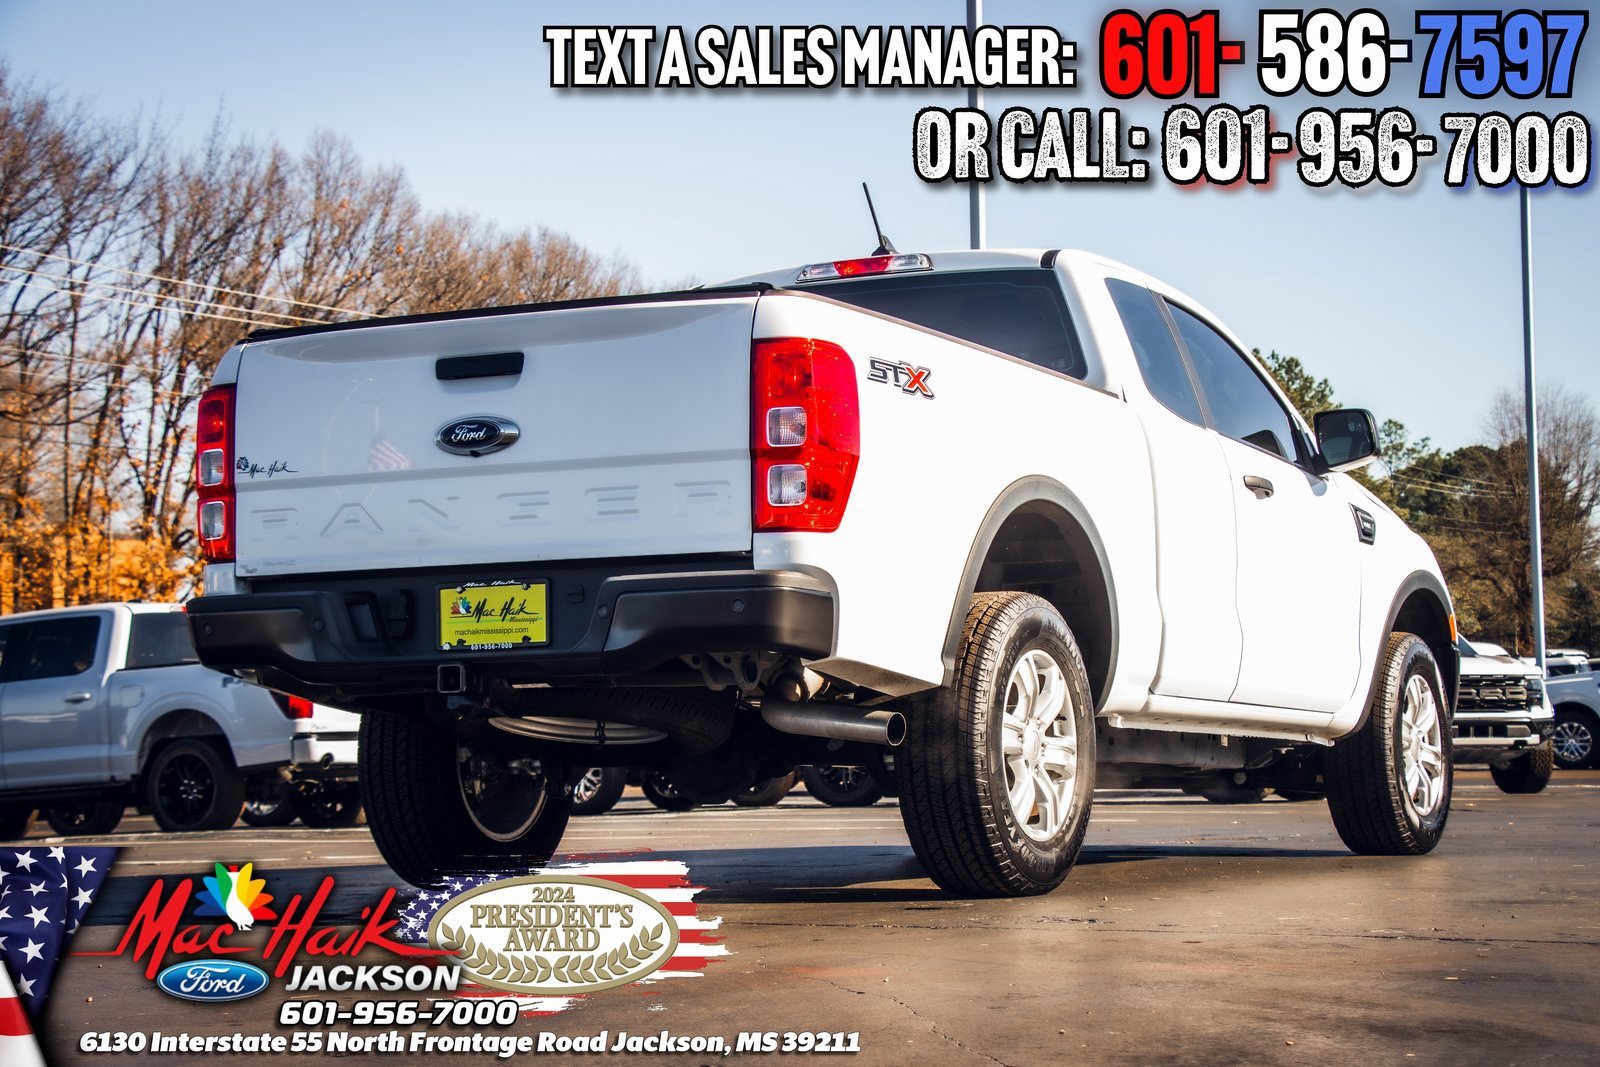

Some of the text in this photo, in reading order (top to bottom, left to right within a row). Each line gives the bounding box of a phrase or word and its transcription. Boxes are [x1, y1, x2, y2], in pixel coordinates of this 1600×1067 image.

[867, 356, 935, 400] STX
[451, 424, 486, 442] Ford
[249, 460, 299, 479] Mac Haik
[250, 480, 732, 542] RANGER
[470, 596, 539, 623] Mac Haik
[455, 626, 529, 637] machaikmississippi.com
